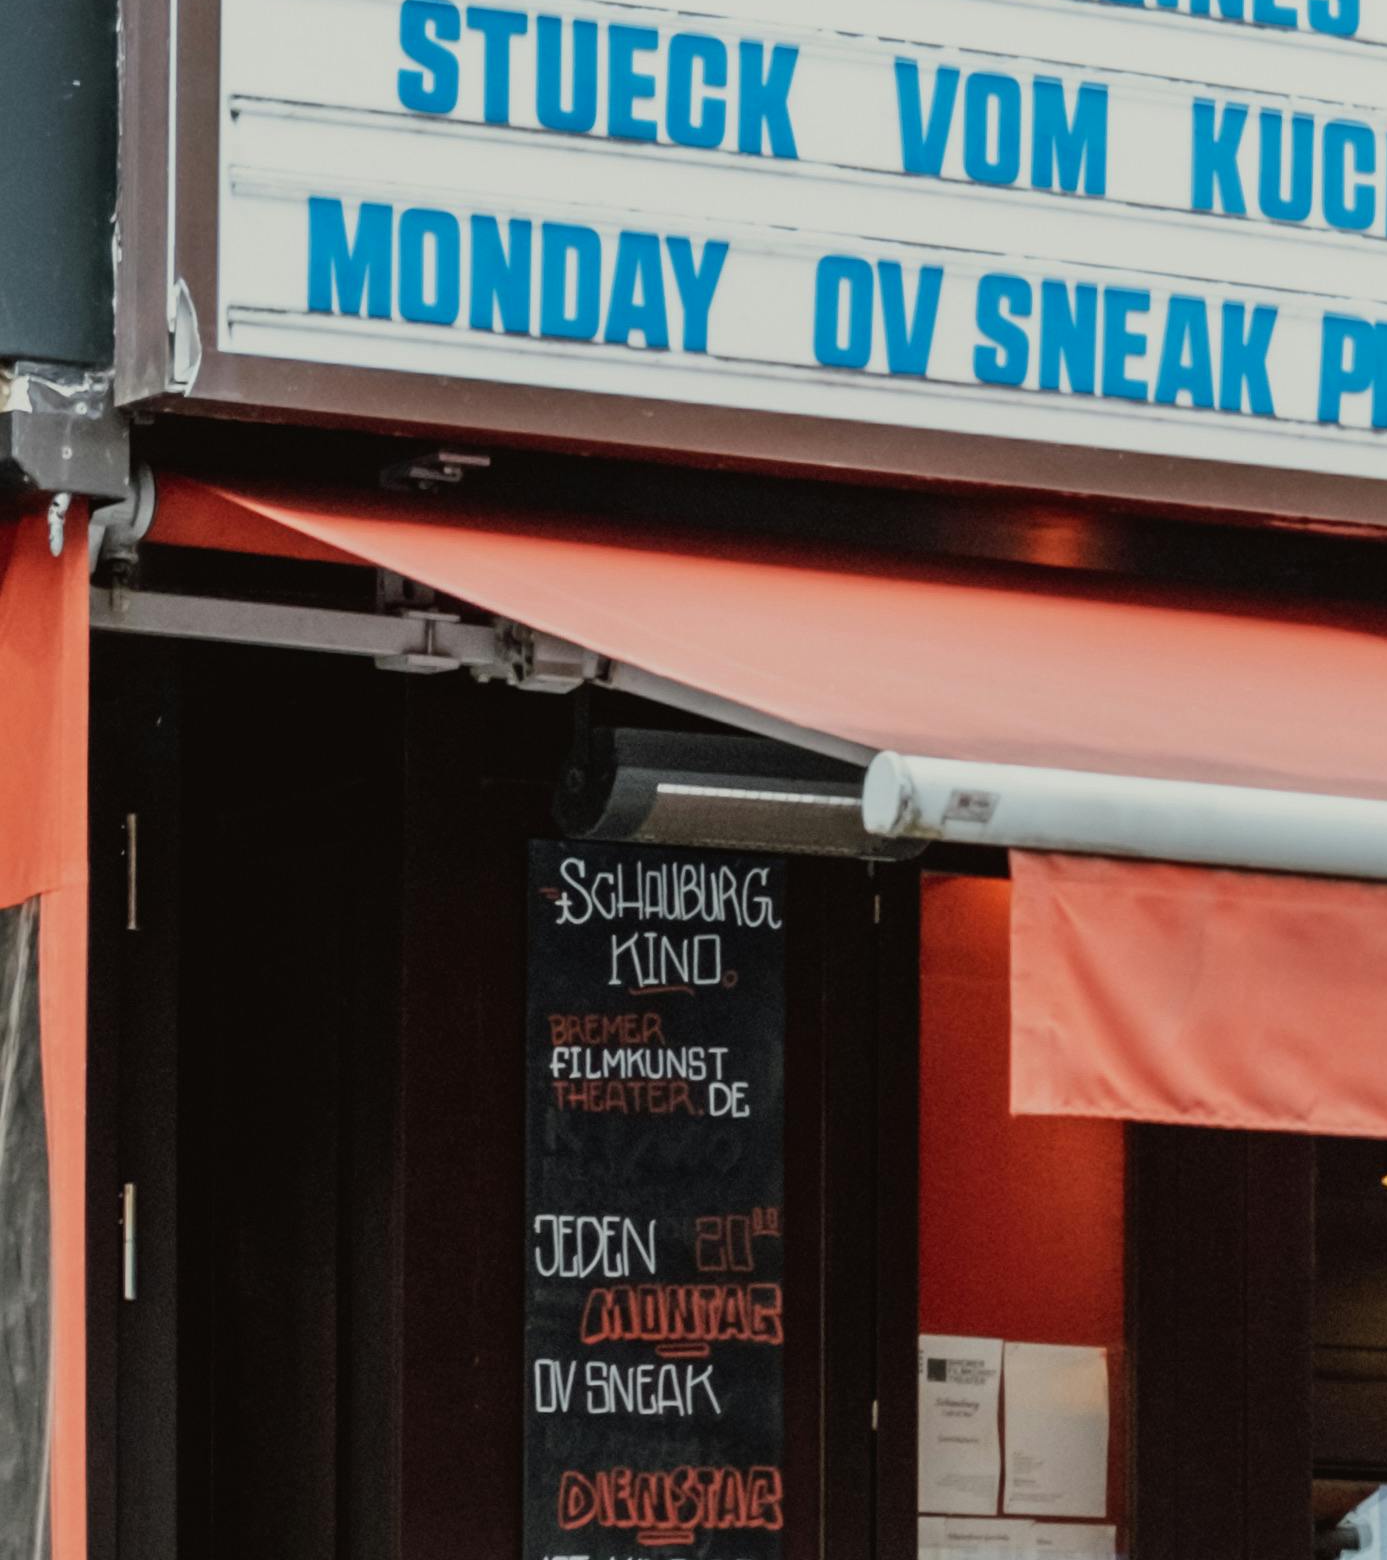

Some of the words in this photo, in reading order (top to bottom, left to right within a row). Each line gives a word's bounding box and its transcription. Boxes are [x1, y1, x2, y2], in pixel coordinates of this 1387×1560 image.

[895, 57, 1108, 196] VOM
[308, 196, 729, 353] MONDAY
[814, 255, 943, 376] OV
[973, 273, 1278, 417] SNEAK
[555, 857, 782, 929] SCHAUBURG
[549, 1013, 665, 1045] BREMER
[550, 1047, 728, 1080] FILMKUNST
[535, 1215, 656, 1278] JEDEN
[581, 1283, 784, 1345] MONTAG
[535, 1359, 576, 1413] OV
[586, 1361, 721, 1416] SNEAK
[558, 1465, 783, 1530] DIENSTAG
